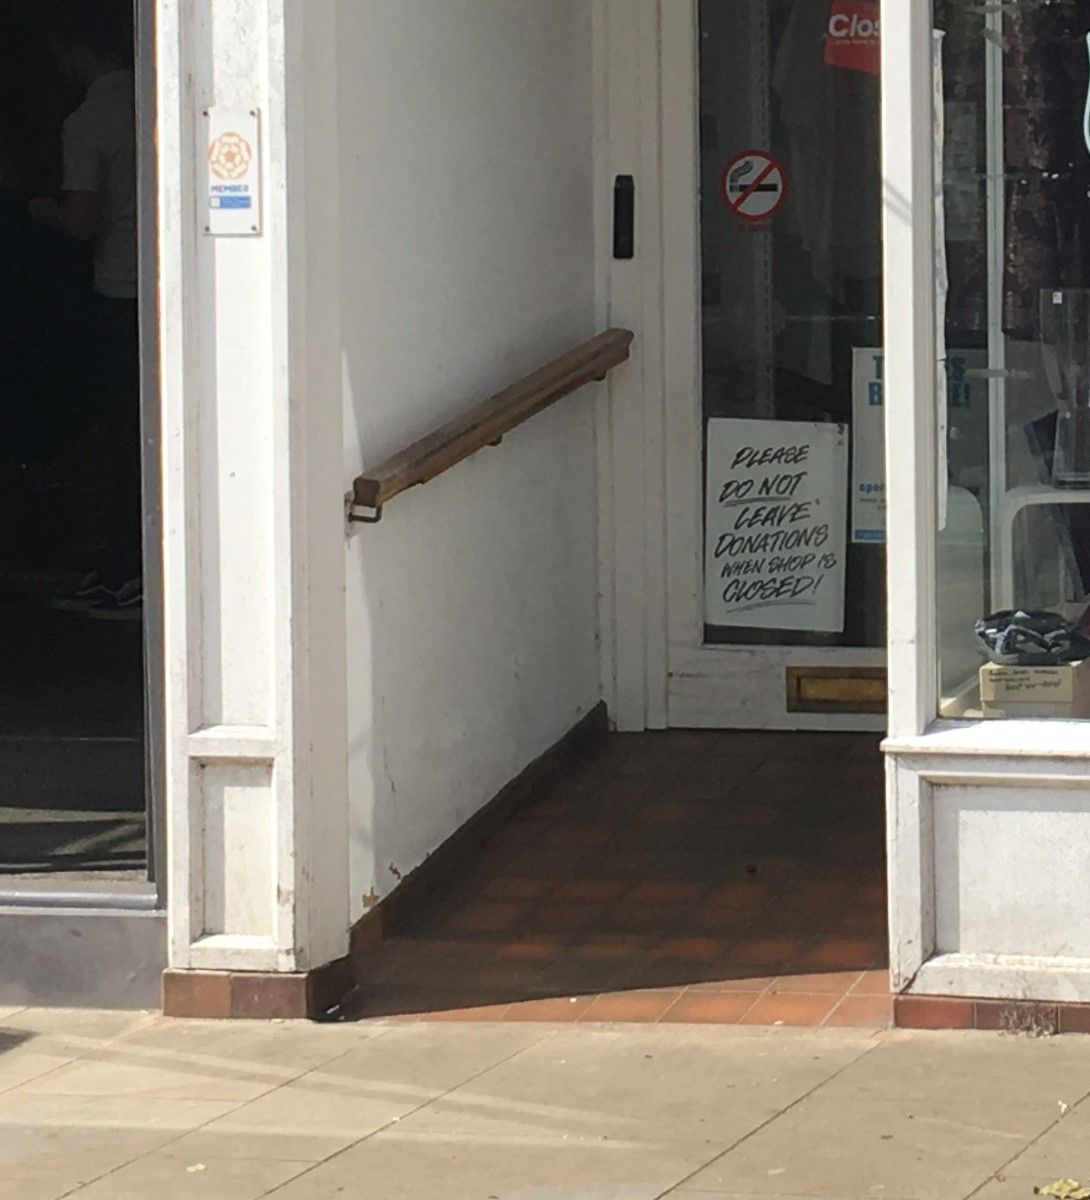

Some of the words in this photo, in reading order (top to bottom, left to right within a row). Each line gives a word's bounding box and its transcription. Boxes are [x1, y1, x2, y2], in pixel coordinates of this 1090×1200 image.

[730, 444, 811, 469] PLEASE
[718, 479, 755, 503] DO
[758, 471, 808, 495] NOT
[733, 501, 812, 530] LEAVE
[714, 524, 830, 558] DONATIONS
[720, 557, 767, 578] WHEN
[768, 552, 817, 574] SHOP
[817, 552, 838, 569] IS
[722, 573, 825, 603] CLOSED!
